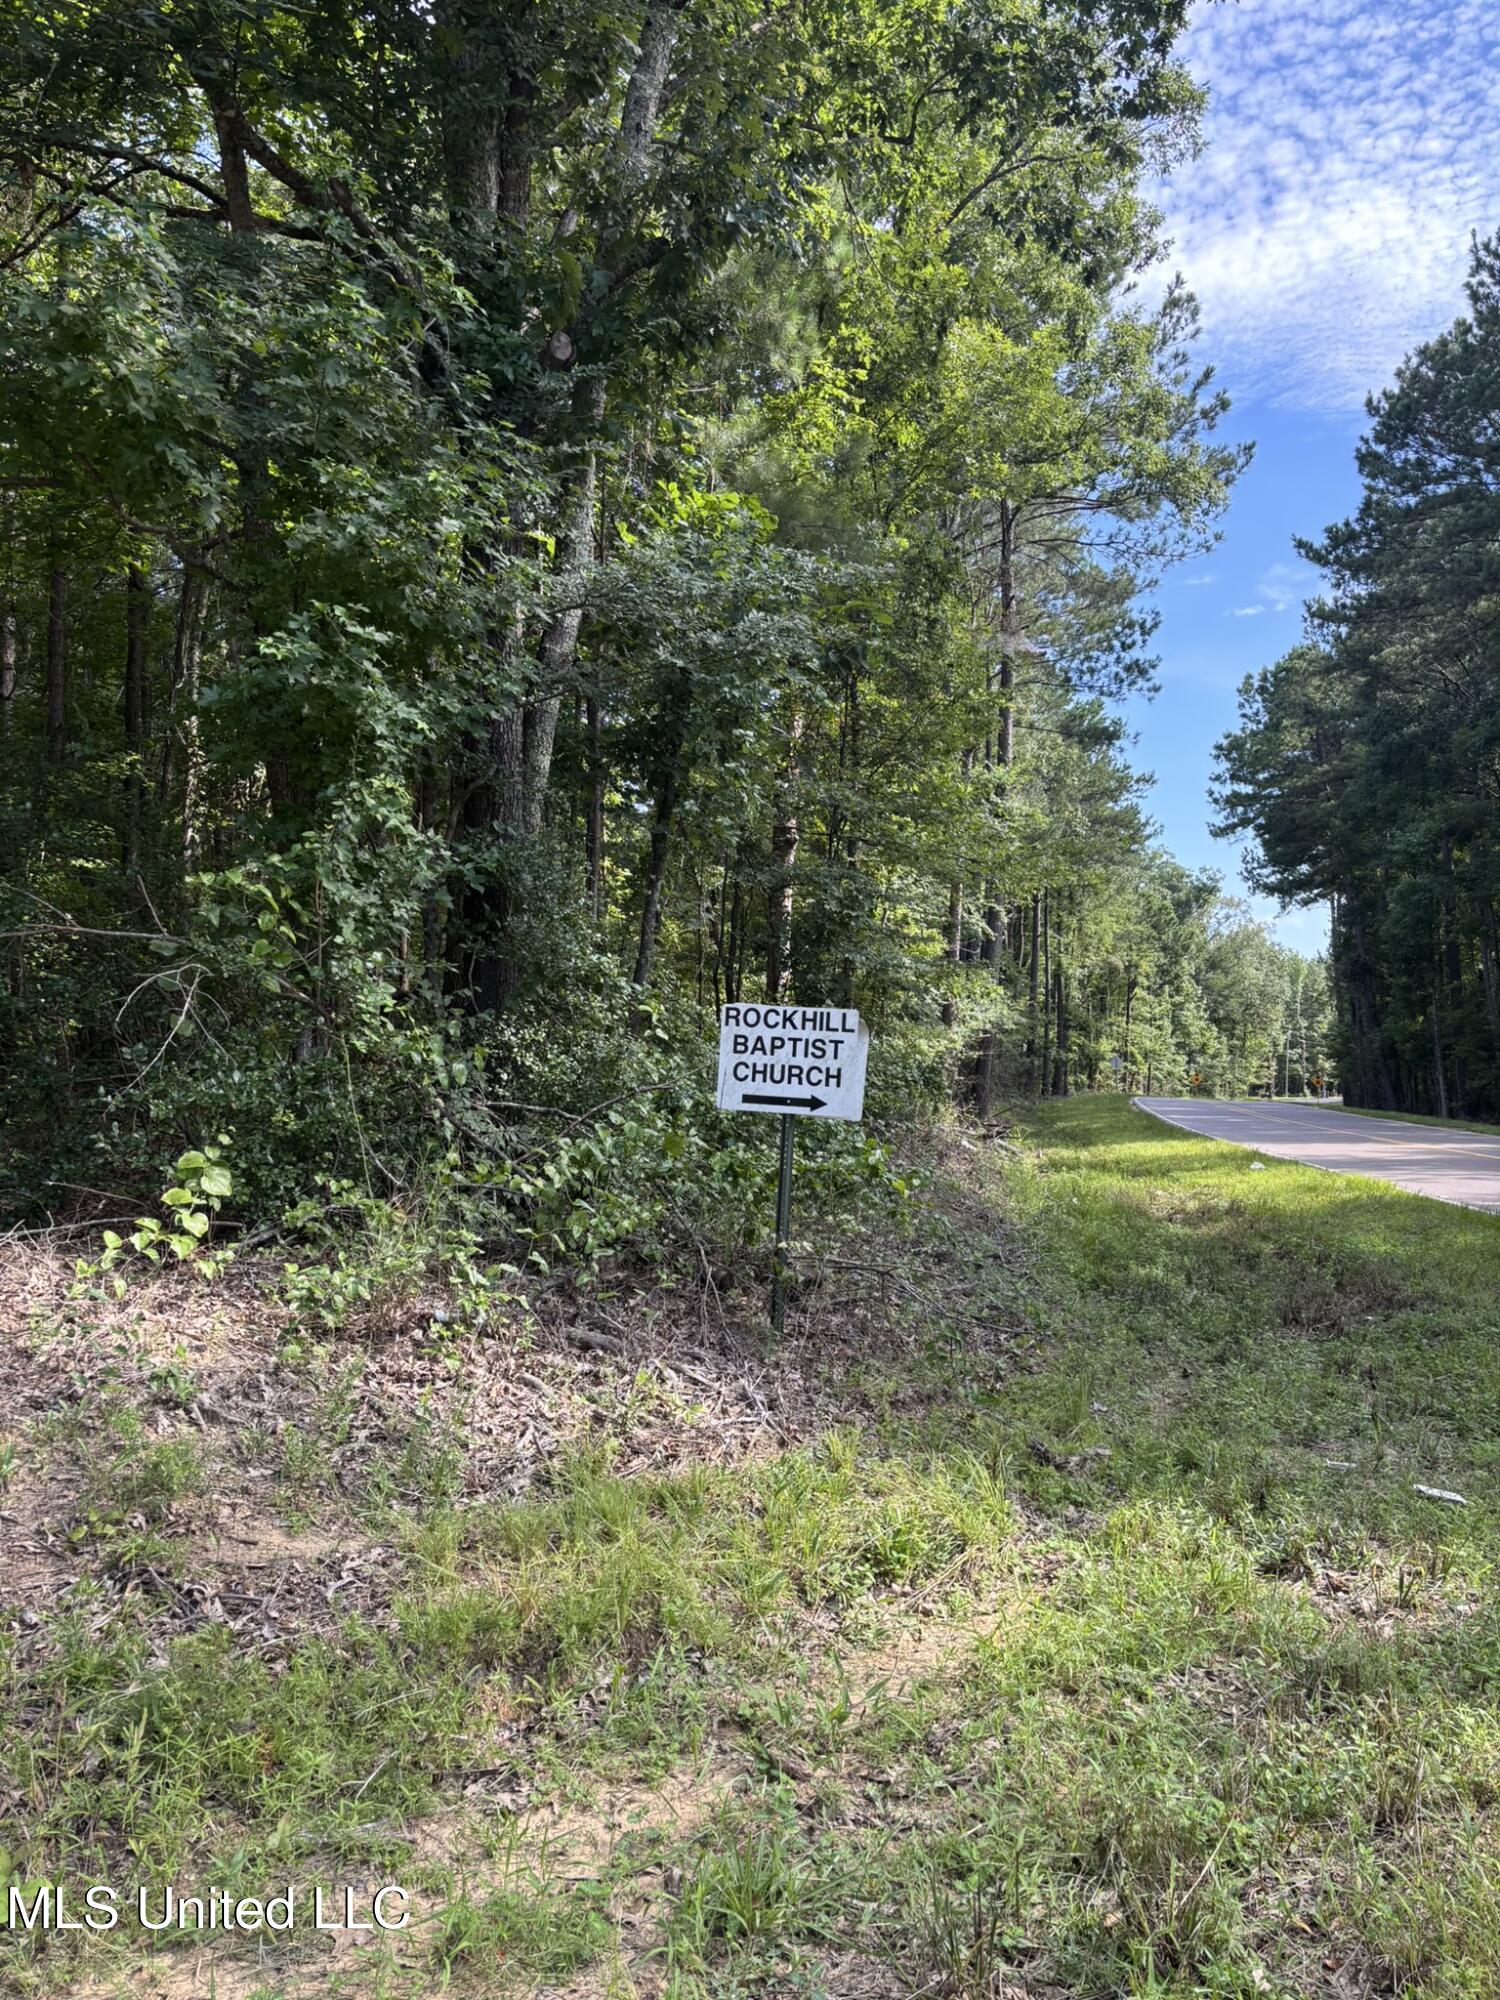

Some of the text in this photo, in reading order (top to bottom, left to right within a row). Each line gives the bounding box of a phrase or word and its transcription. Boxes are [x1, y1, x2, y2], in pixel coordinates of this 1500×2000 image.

[725, 1007, 855, 1033] ROCKHILL
[733, 1034, 844, 1060] BAPTIST
[733, 1061, 842, 1088] CHURCH
